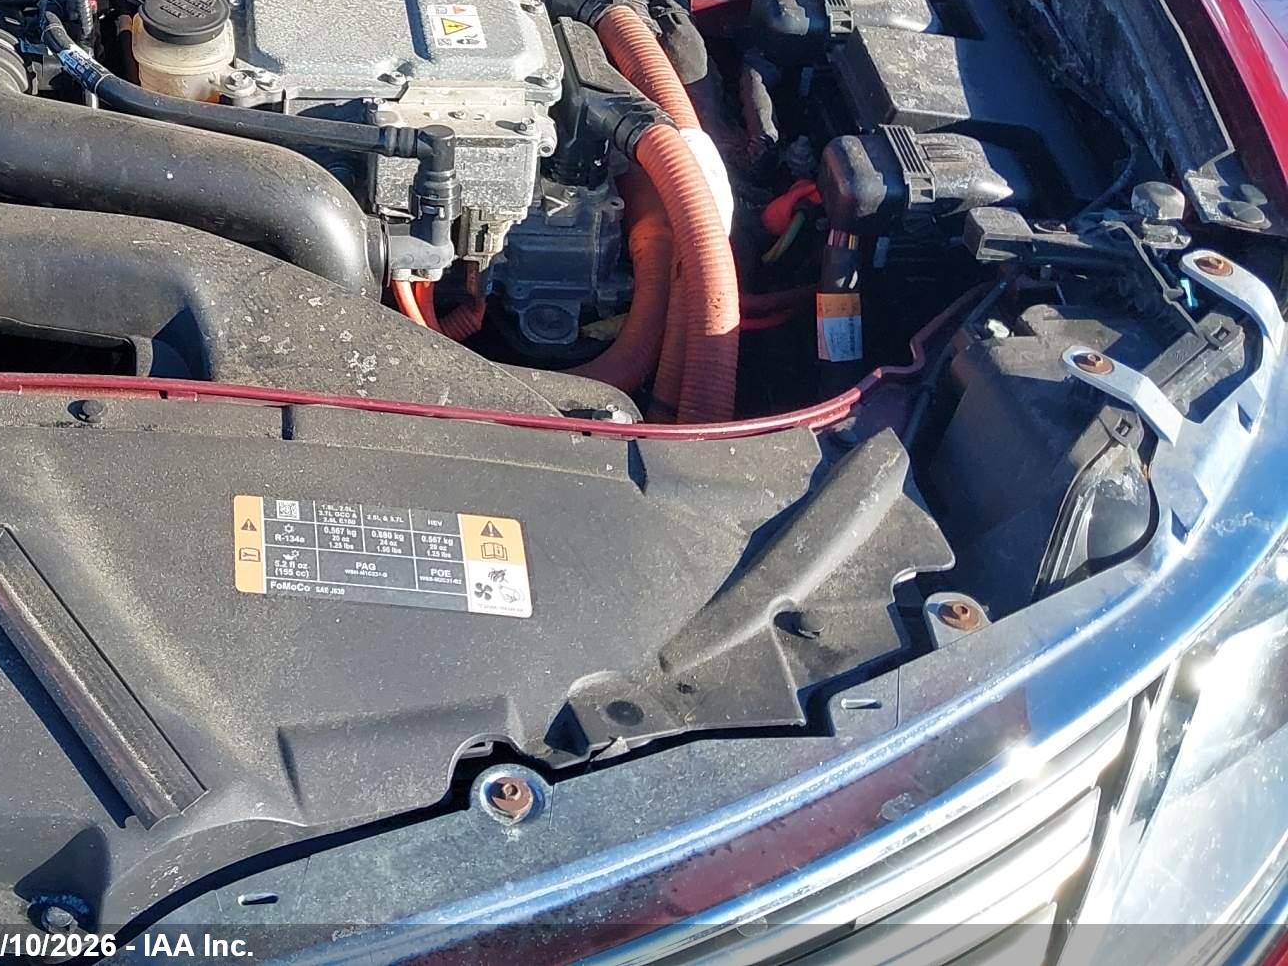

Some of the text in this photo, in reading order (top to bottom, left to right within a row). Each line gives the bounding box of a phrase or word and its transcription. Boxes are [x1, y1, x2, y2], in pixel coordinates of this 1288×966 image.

[427, 519, 443, 527] HEV
[323, 526, 357, 537] 0.567 kg
[274, 533, 305, 543] R-134a
[394, 532, 405, 542] kg
[421, 535, 454, 547] 0.567 kg
[328, 541, 354, 550] 1.25 lbs
[391, 546, 402, 554] lbs
[274, 560, 288, 568] 5.2
[289, 560, 296, 568] fl
[355, 561, 377, 571] PAG
[274, 568, 310, 578] (155 cc)
[430, 568, 452, 577] POE
[270, 581, 311, 592] FoMoCo
[315, 585, 330, 594] SAE
